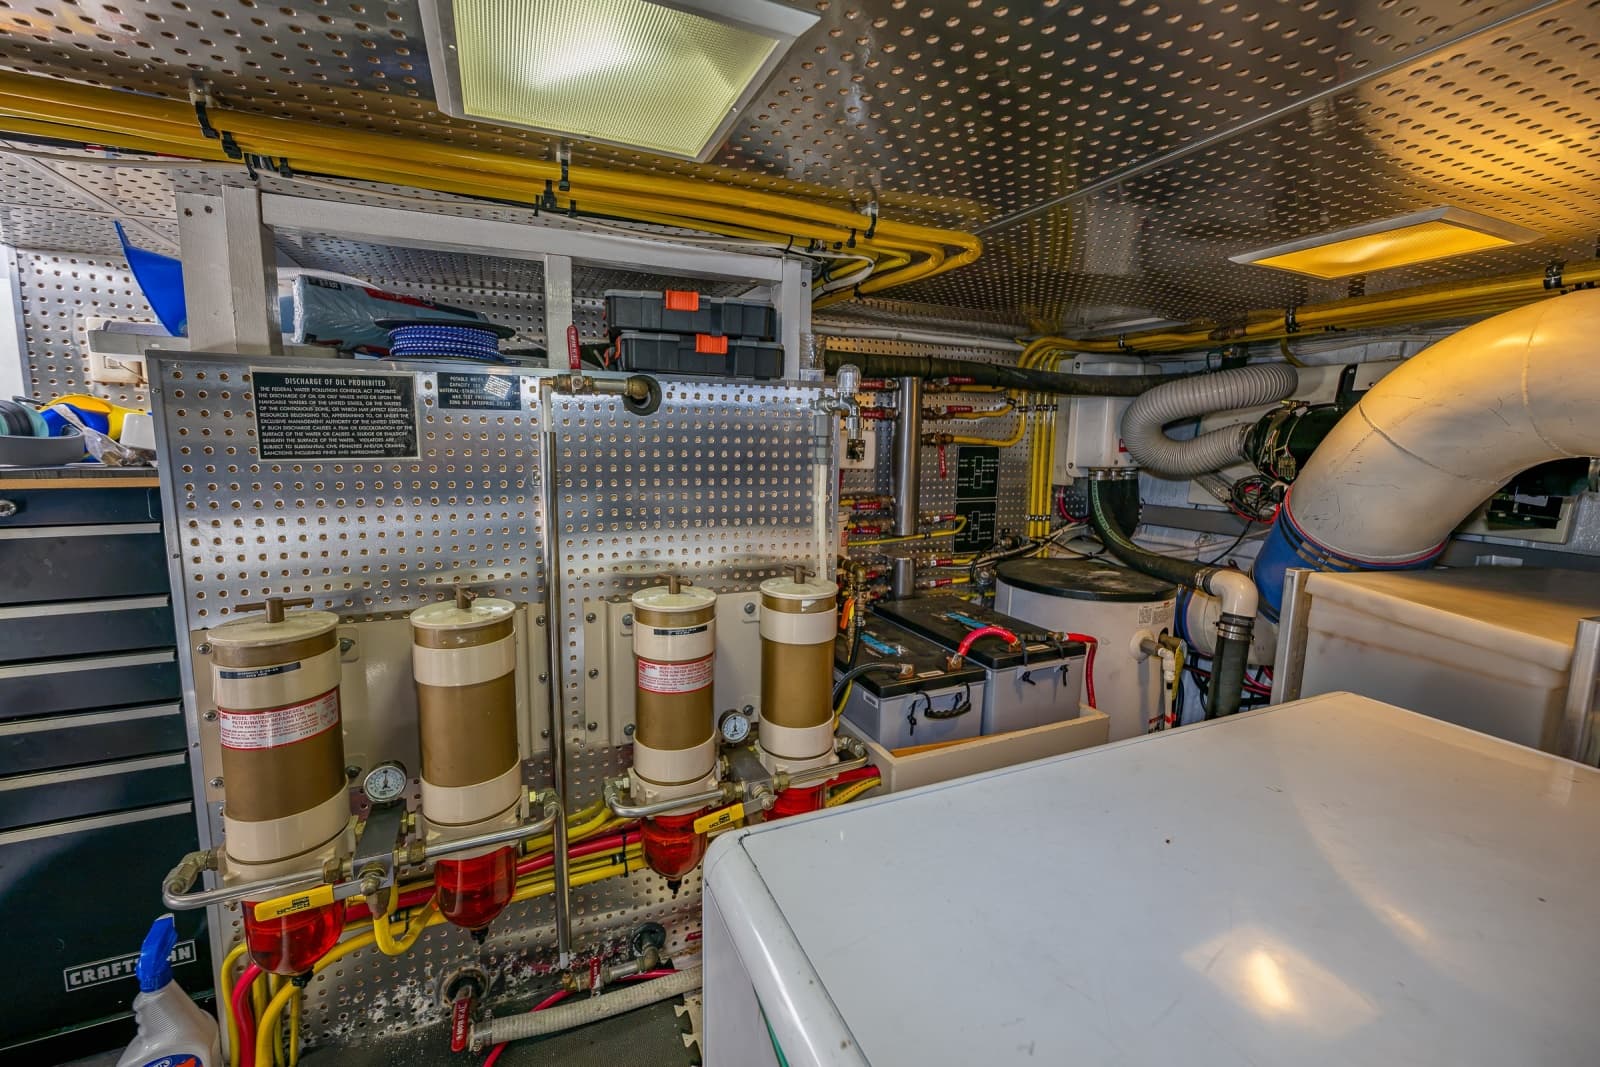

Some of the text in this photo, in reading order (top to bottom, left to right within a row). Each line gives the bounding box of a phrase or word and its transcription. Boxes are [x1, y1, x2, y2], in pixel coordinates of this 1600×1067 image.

[285, 377, 385, 387] DISCHARGE OF OIL PROHIBITED
[70, 946, 192, 986] CRAFTAN
